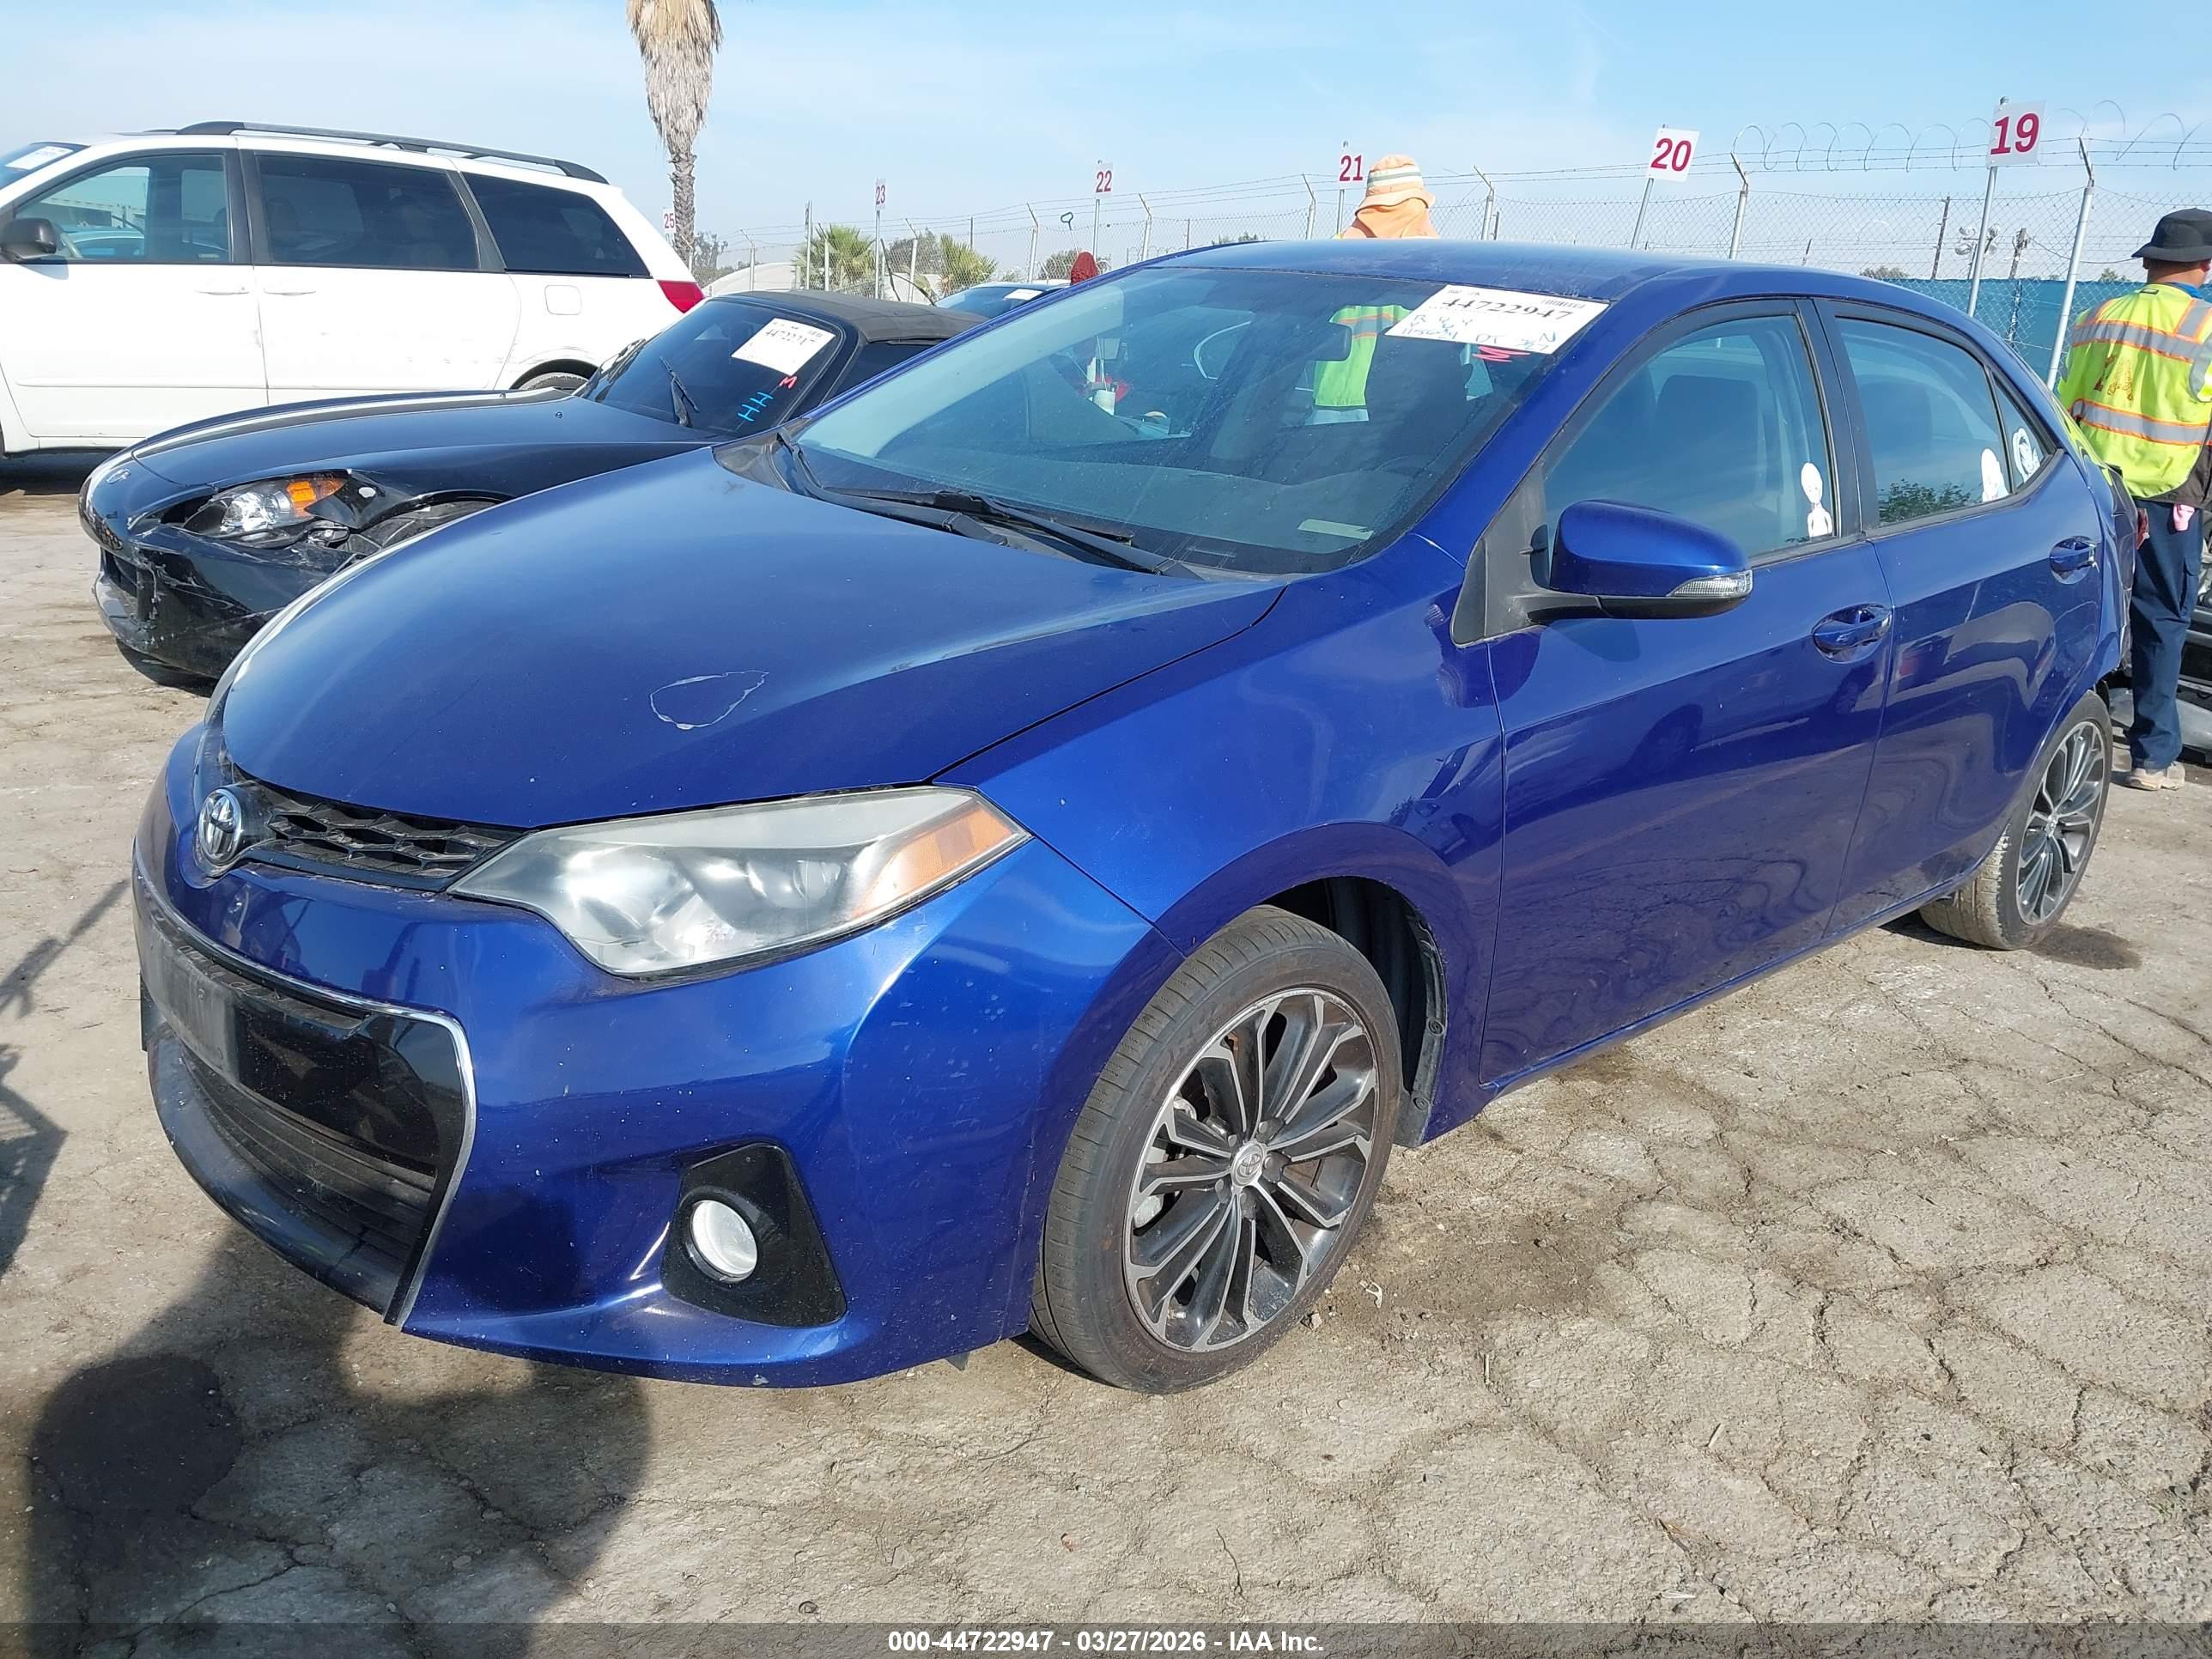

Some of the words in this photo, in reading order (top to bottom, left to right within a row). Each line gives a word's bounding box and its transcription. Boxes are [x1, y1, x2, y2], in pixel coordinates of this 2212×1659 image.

[1990, 112, 2039, 155] 19
[1650, 137, 1692, 172] 20
[1339, 154, 1364, 181] 21
[1096, 169, 1112, 193] 22
[875, 184, 886, 205] 23
[663, 212, 675, 229] 25
[1442, 298, 1574, 320] 44722947
